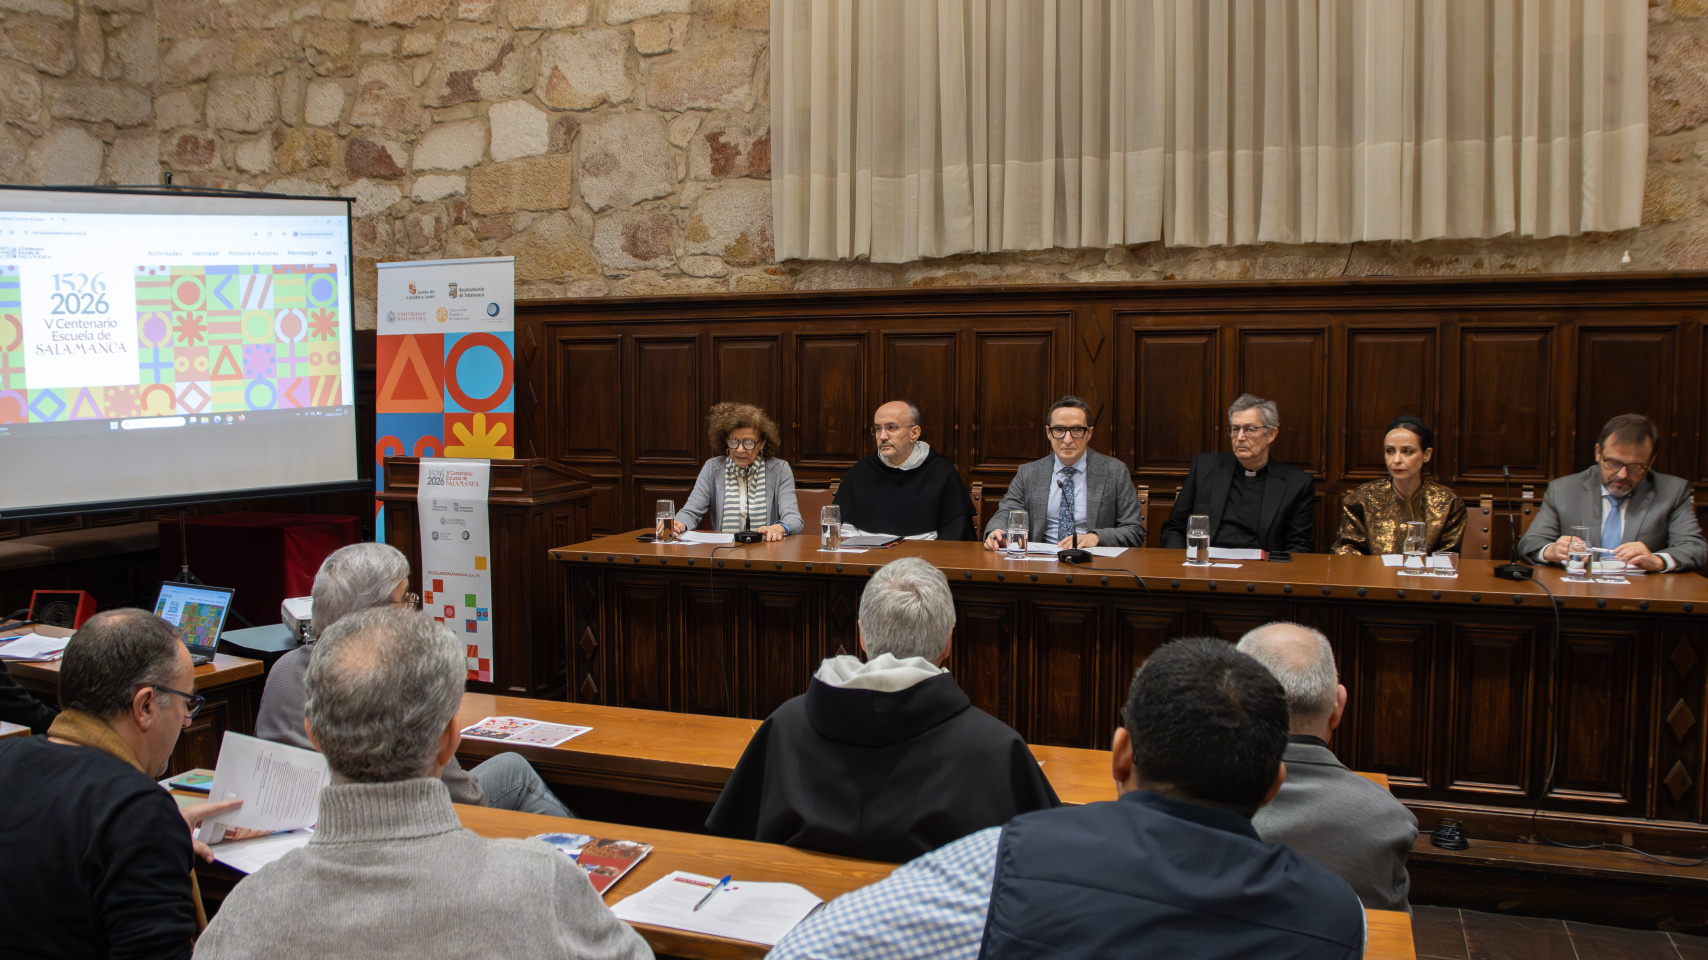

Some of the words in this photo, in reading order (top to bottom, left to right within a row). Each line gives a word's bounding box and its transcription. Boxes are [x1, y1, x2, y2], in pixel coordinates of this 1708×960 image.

[51, 271, 106, 294] 1526
[50, 293, 109, 315] 2026
[44, 318, 54, 329] V
[56, 317, 118, 329] Centenario
[52, 330, 94, 341] Escuela
[97, 330, 111, 341] de
[36, 342, 127, 356] SALAMANCA
[427, 477, 445, 485] 2026
